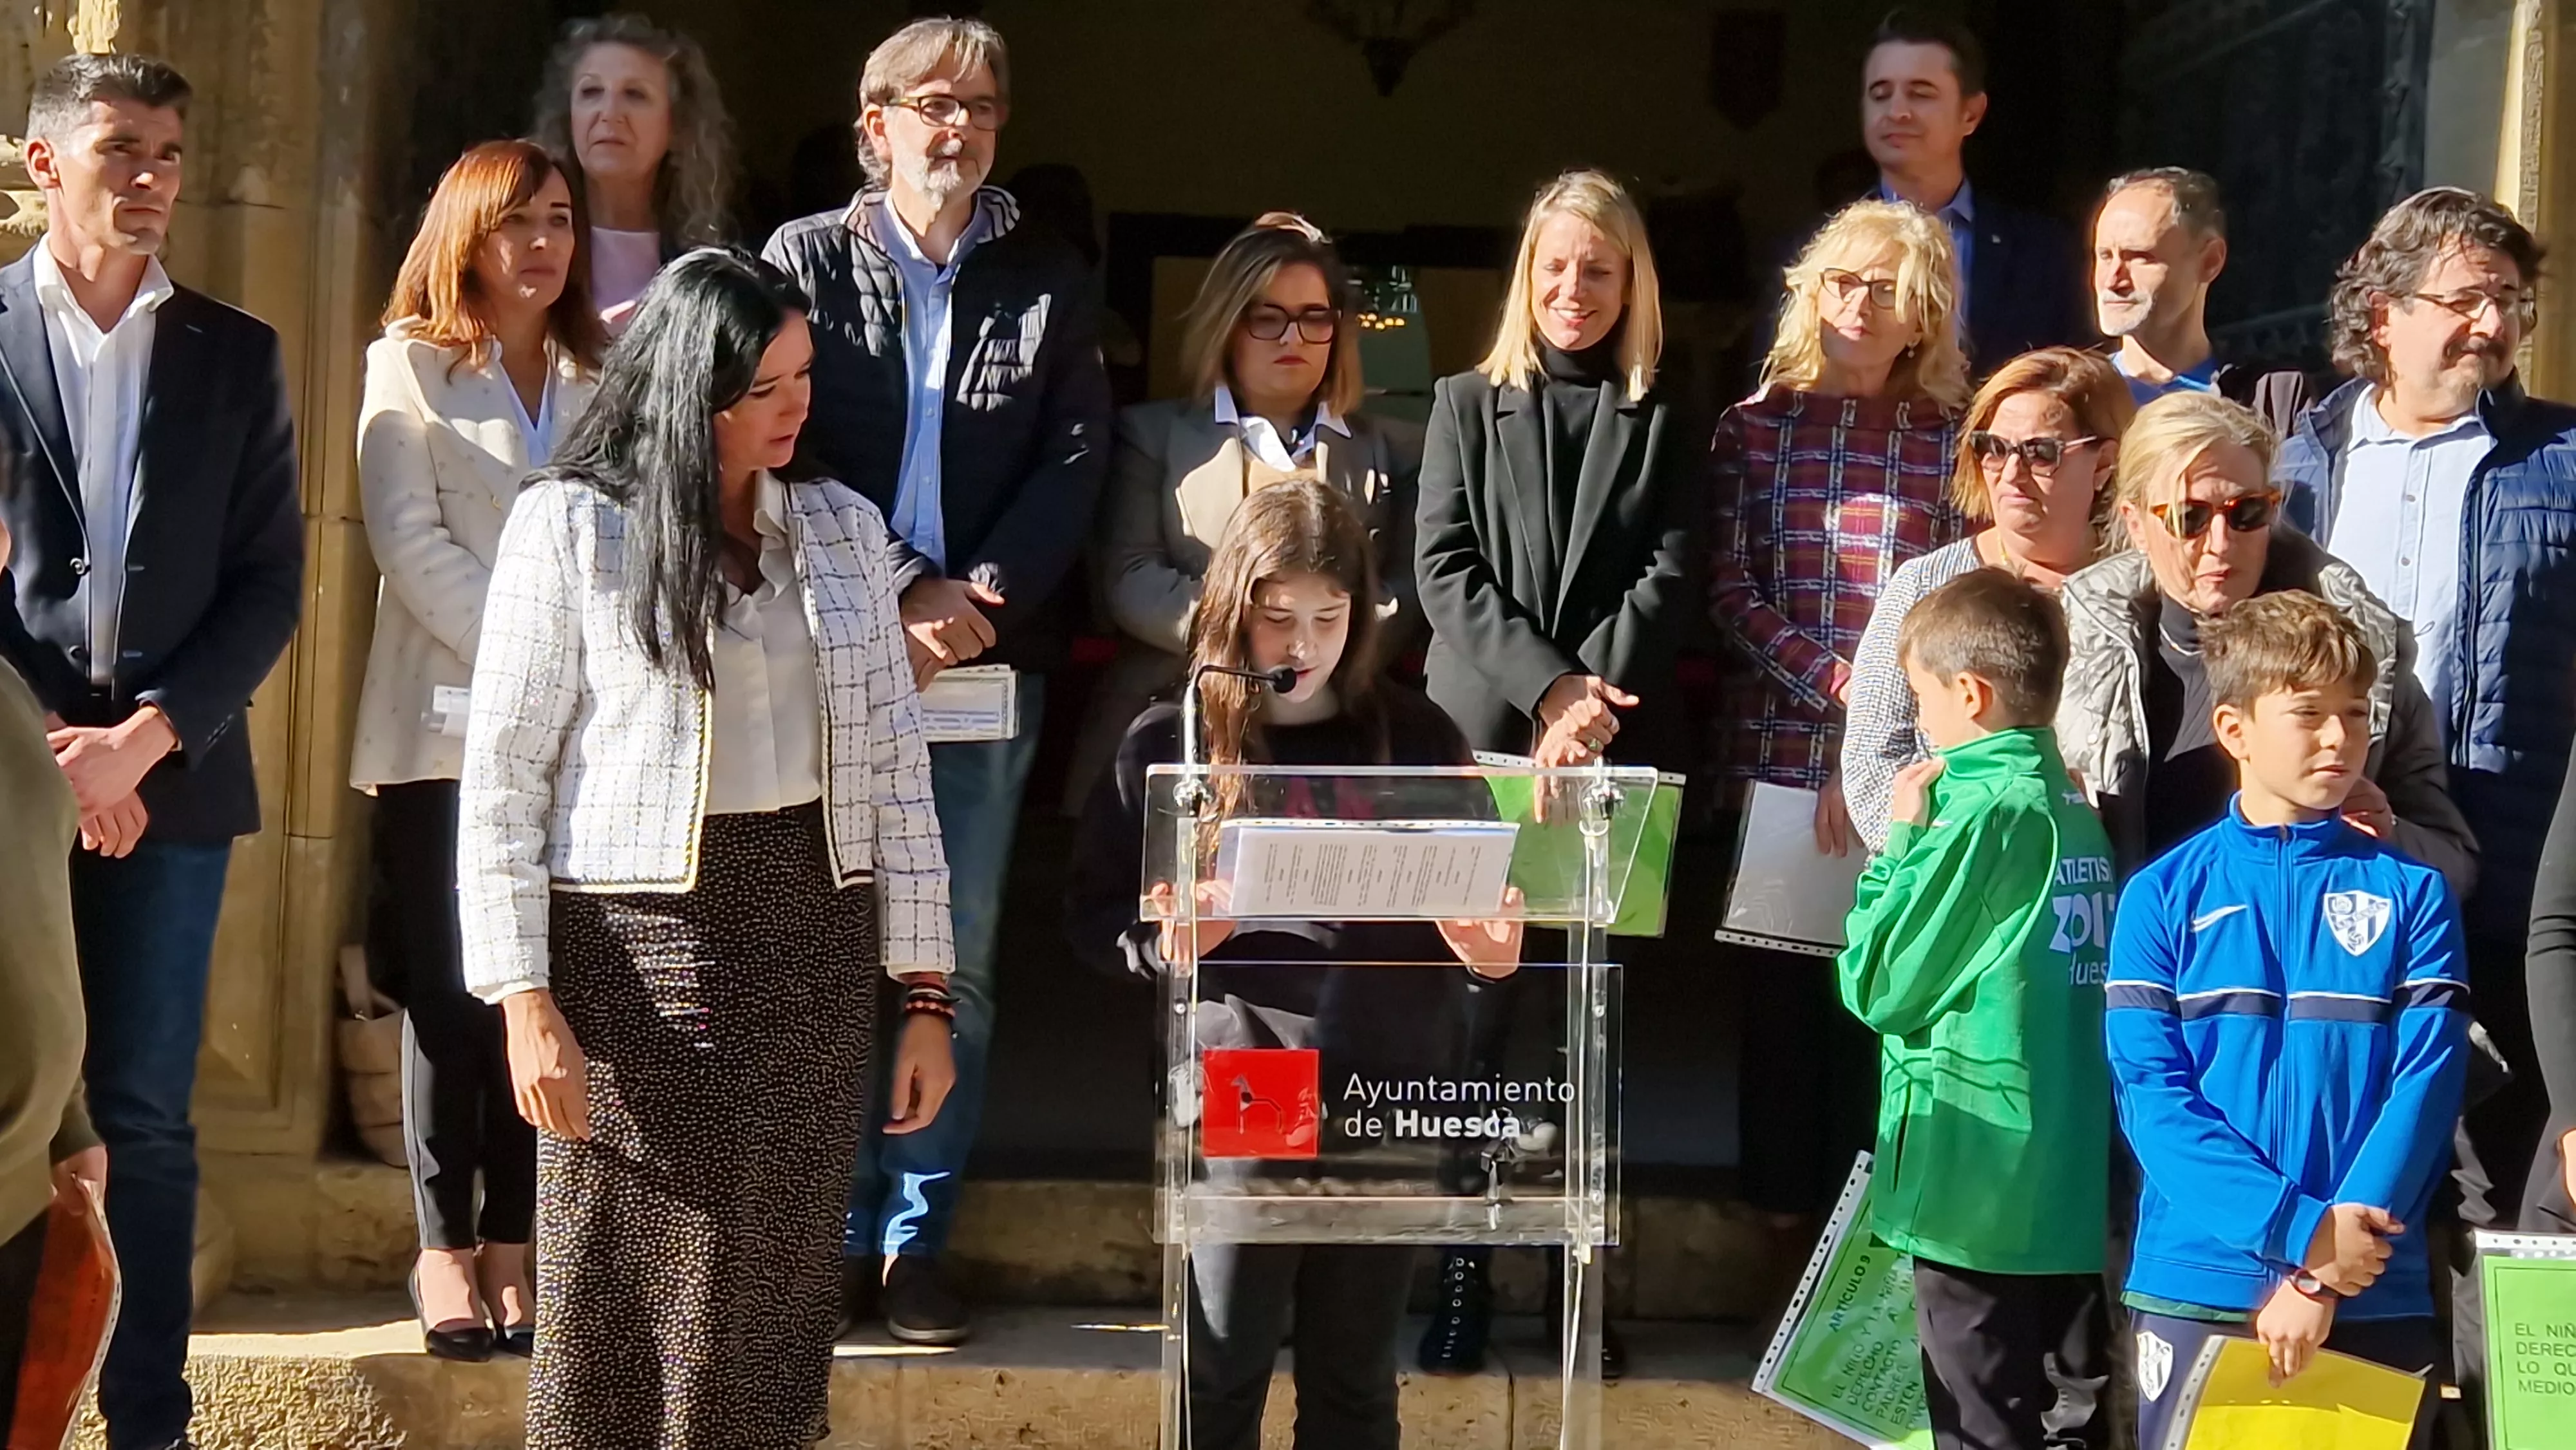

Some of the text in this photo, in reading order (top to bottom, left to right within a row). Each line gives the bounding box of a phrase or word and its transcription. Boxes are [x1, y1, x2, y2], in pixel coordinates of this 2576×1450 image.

[2053, 857, 2114, 885] ATLETIS
[1343, 1072, 1575, 1108] Ayuntamiento
[1344, 1109, 1520, 1137] de Huesca
[2515, 1322, 2536, 1337] EL
[2517, 1360, 2540, 1375] LO
